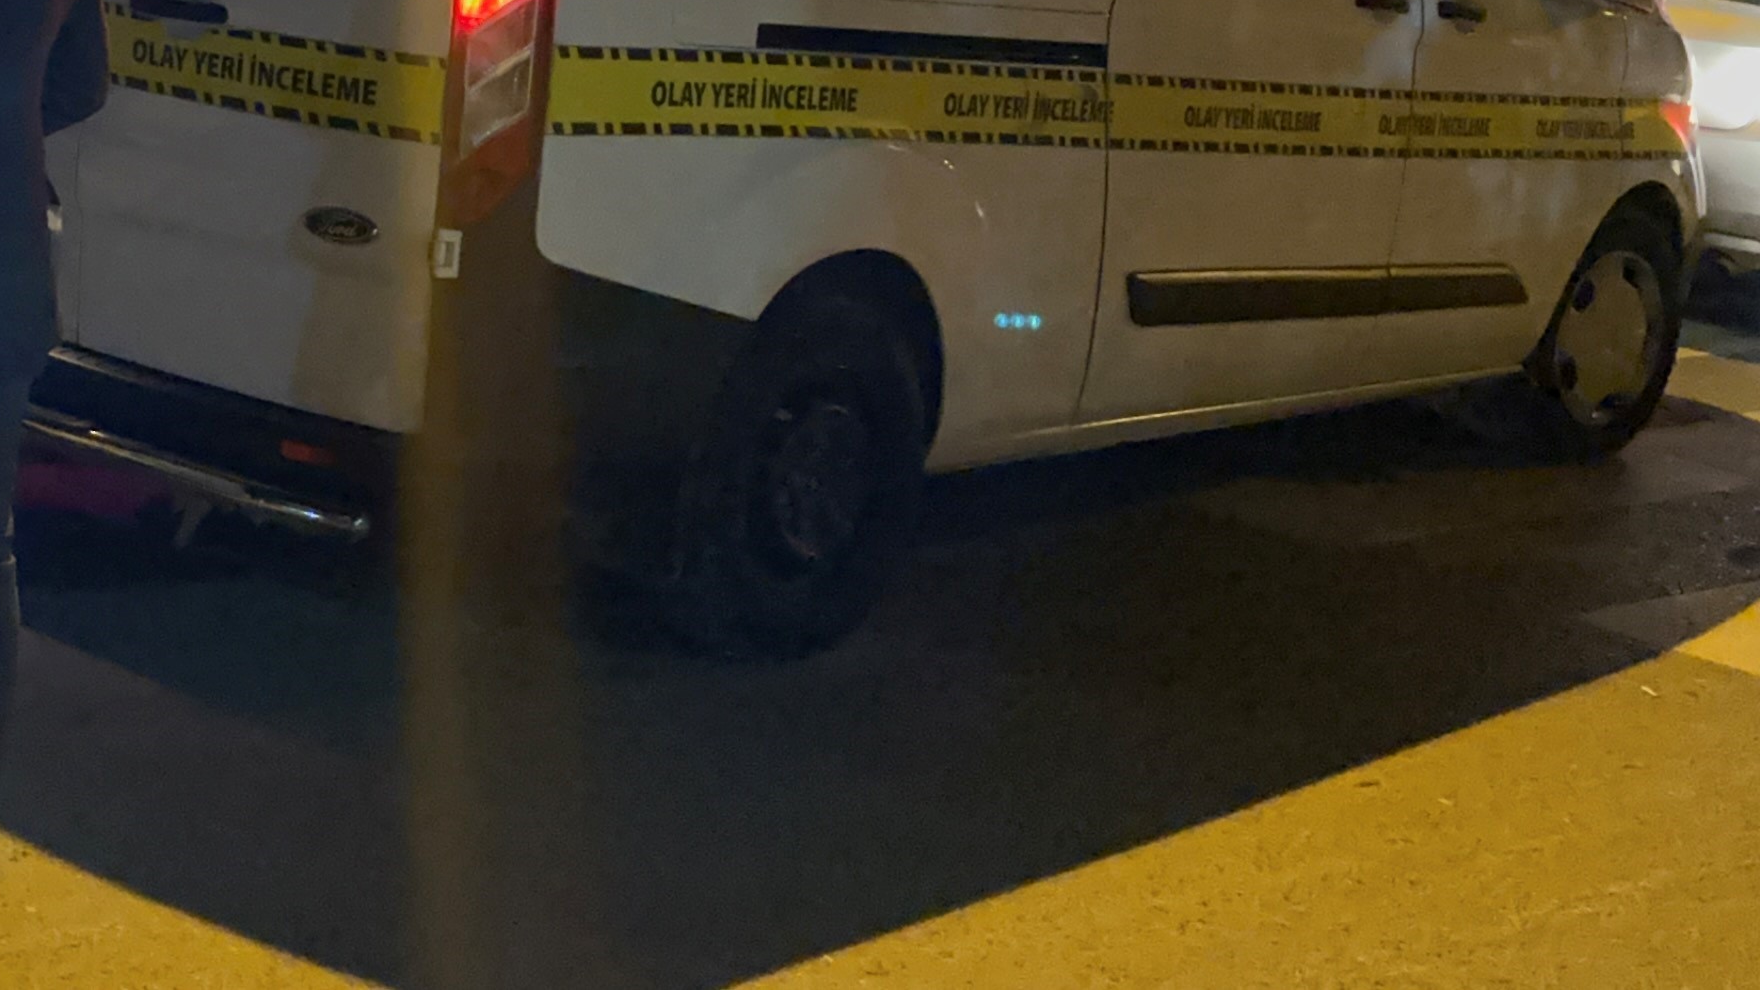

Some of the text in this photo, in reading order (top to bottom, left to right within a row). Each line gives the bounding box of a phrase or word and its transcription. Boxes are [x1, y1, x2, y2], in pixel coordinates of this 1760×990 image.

[131, 38, 378, 107] OLAY YERİ İNCELEME
[651, 77, 859, 112] OLAY YERİ İNCELEME
[943, 90, 1115, 123] OLAY YERİ İNCELEME
[1183, 105, 1222, 128] OLAY
